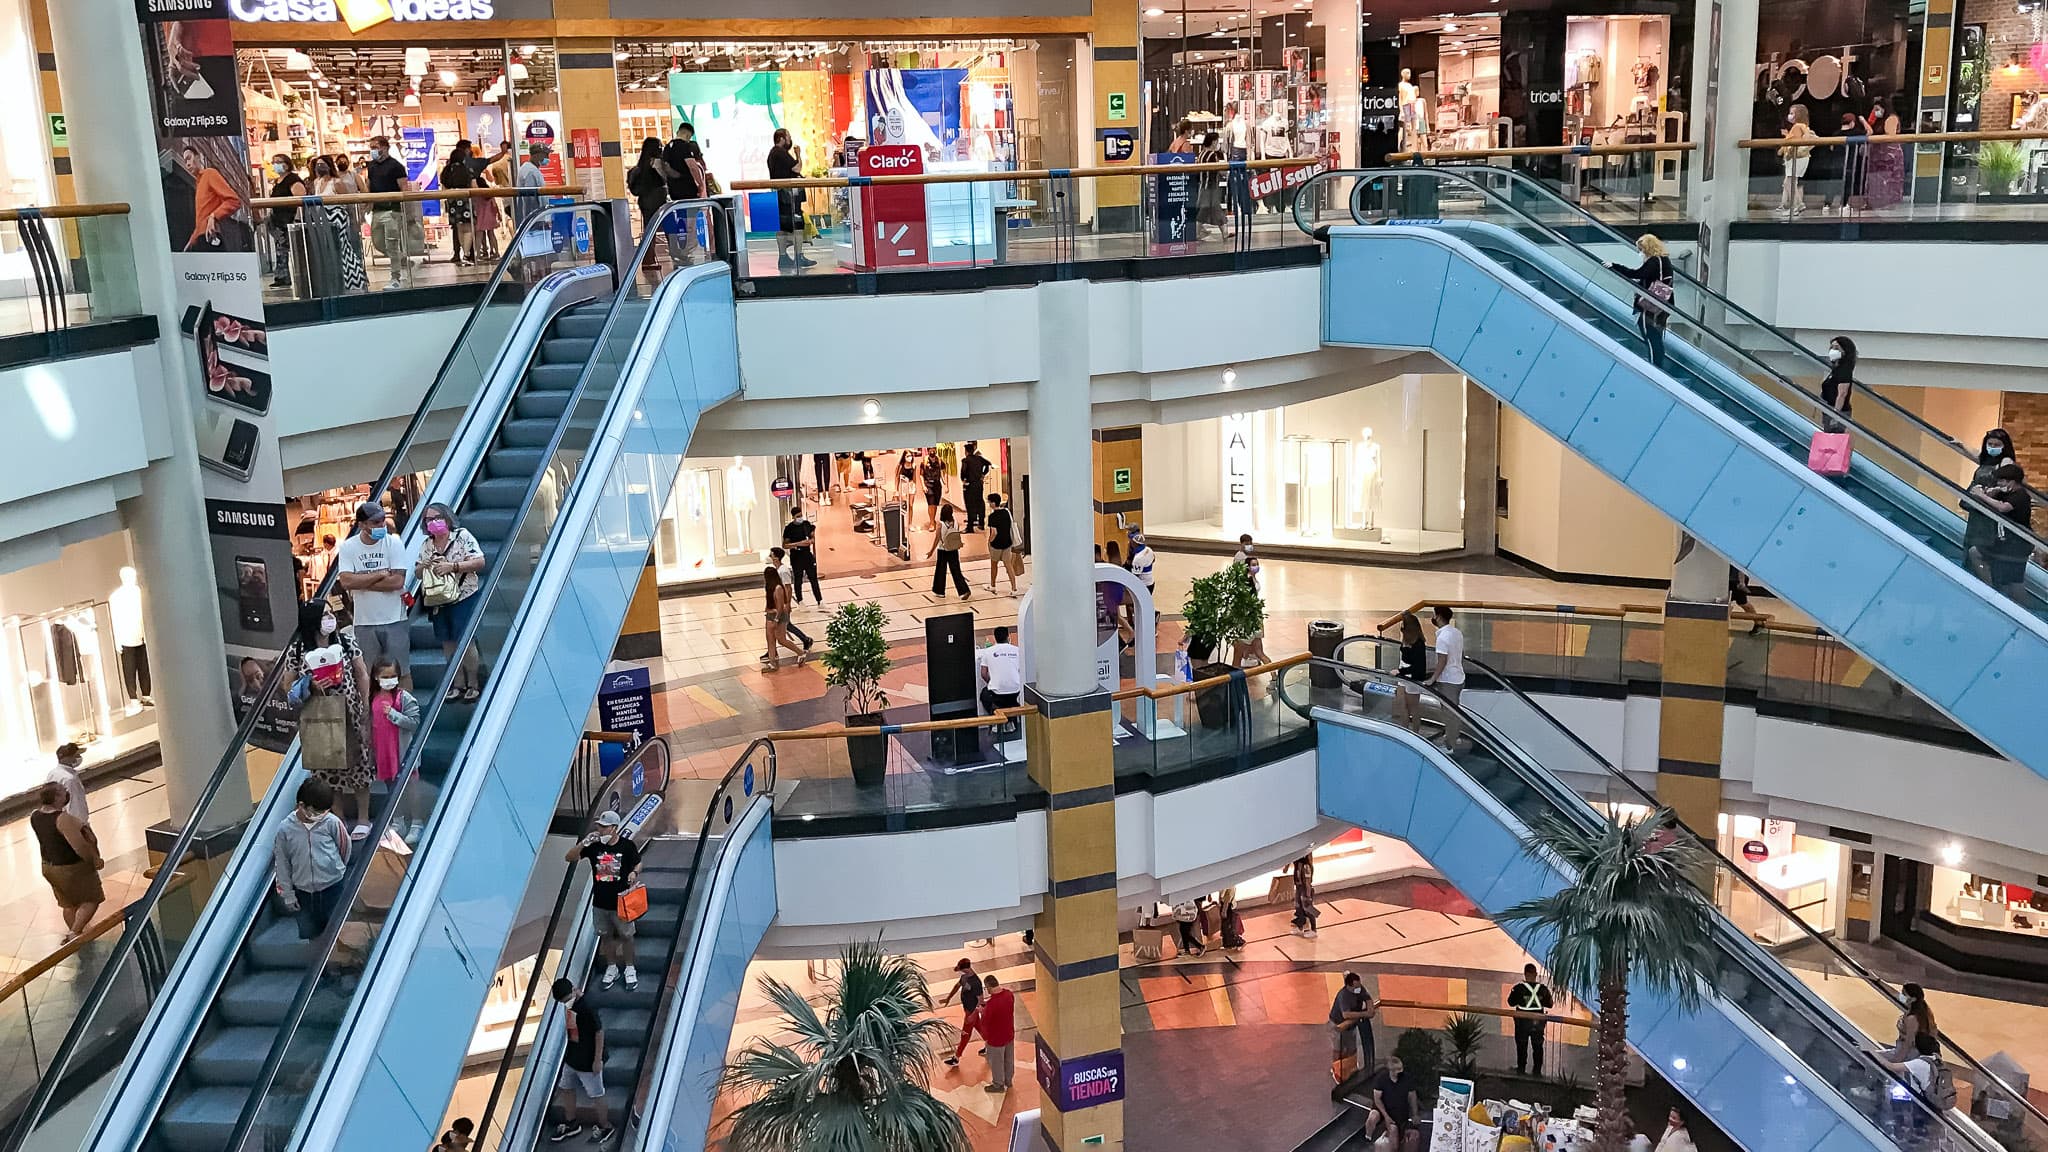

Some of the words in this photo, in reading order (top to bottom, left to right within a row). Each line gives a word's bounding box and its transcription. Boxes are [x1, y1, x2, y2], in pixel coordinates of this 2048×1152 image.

[148, 0, 212, 12] SAMSUNG
[1363, 96, 1398, 109] tricot
[1530, 90, 1562, 104] tricot
[163, 117, 191, 128] Galaxy
[191, 116, 196, 126] Z
[196, 115, 215, 128] Flip3
[215, 115, 229, 125] 5G
[869, 153, 911, 169] Claro
[1251, 166, 1282, 198] full
[184, 272, 211, 284] Galaxy
[210, 272, 216, 281] Z
[216, 272, 234, 284] Flip3
[235, 272, 248, 282] 5G
[217, 510, 275, 527] SAMSUNG
[1098, 665, 1110, 676] all
